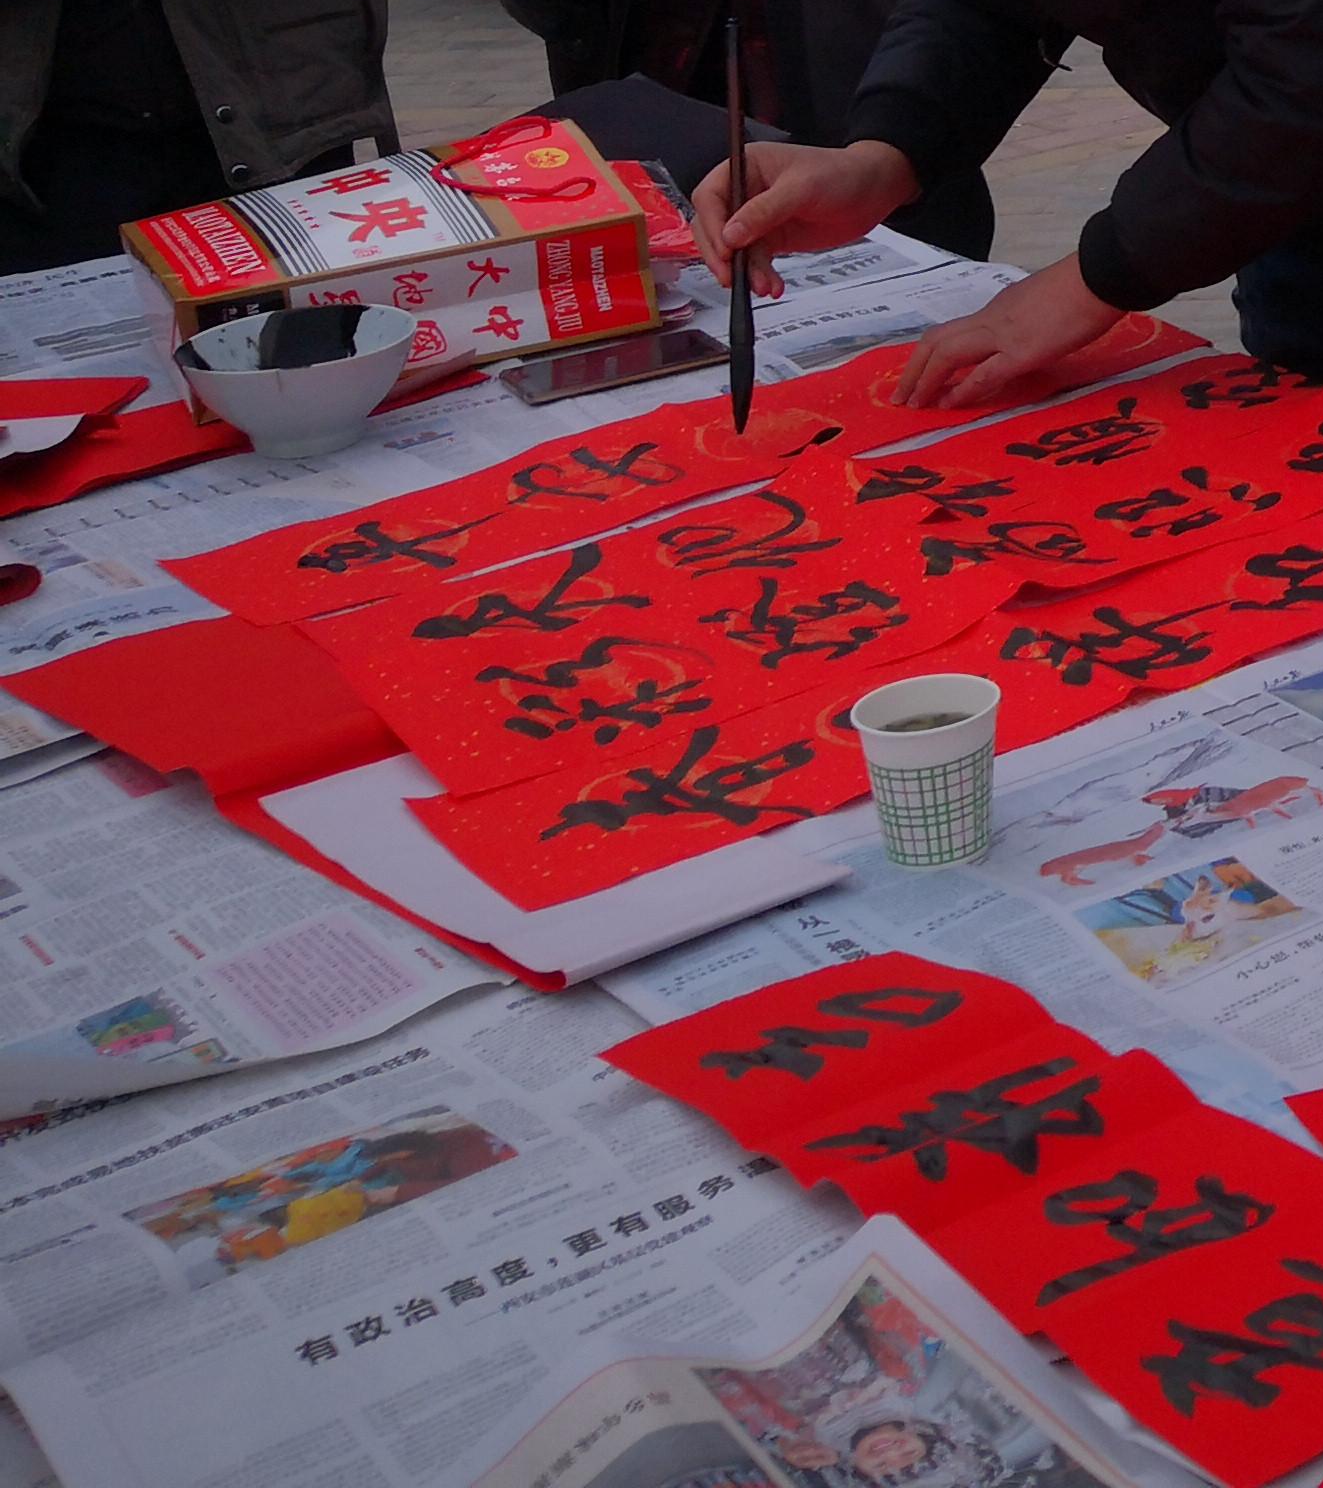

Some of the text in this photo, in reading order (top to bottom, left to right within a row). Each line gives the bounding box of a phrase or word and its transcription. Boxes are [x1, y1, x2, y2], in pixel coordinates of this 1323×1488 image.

[305, 167, 430, 243] 中央
[544, 239, 574, 280] ZHONG
[589, 245, 613, 313] MAOTAIZHEN
[549, 278, 579, 313] YANG
